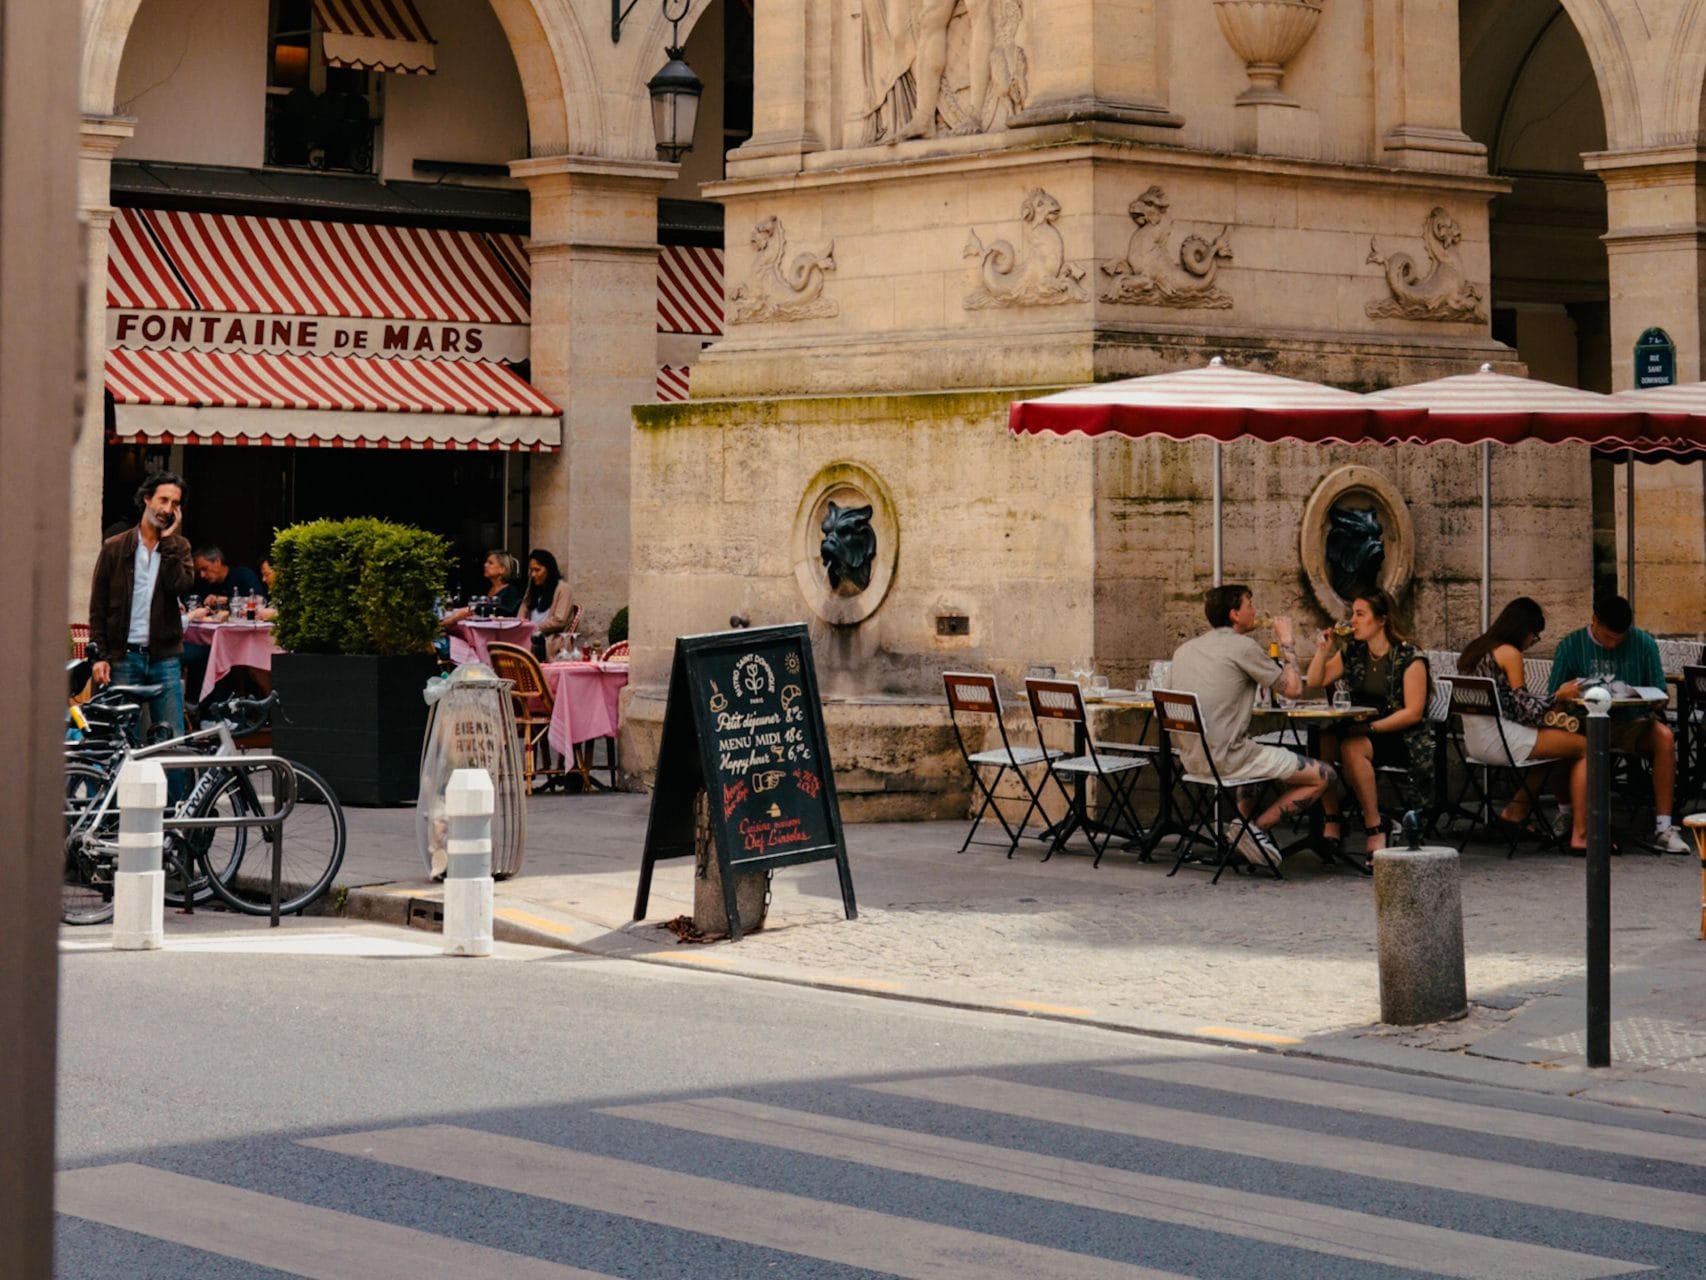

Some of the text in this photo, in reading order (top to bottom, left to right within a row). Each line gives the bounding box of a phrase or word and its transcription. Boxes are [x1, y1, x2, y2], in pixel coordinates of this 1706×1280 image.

[116, 314, 483, 354] FONTAINE DE MARS
[1649, 354, 1660, 362] RUE
[1647, 365, 1662, 373] SAINT
[1641, 376, 1669, 384] DOMINIQUE
[736, 653, 754, 669] SAINT
[715, 711, 745, 733] Petit
[718, 736, 752, 752] MENU
[755, 731, 782, 747] MIDI
[719, 752, 751, 775] Happy
[749, 749, 770, 766] hour
